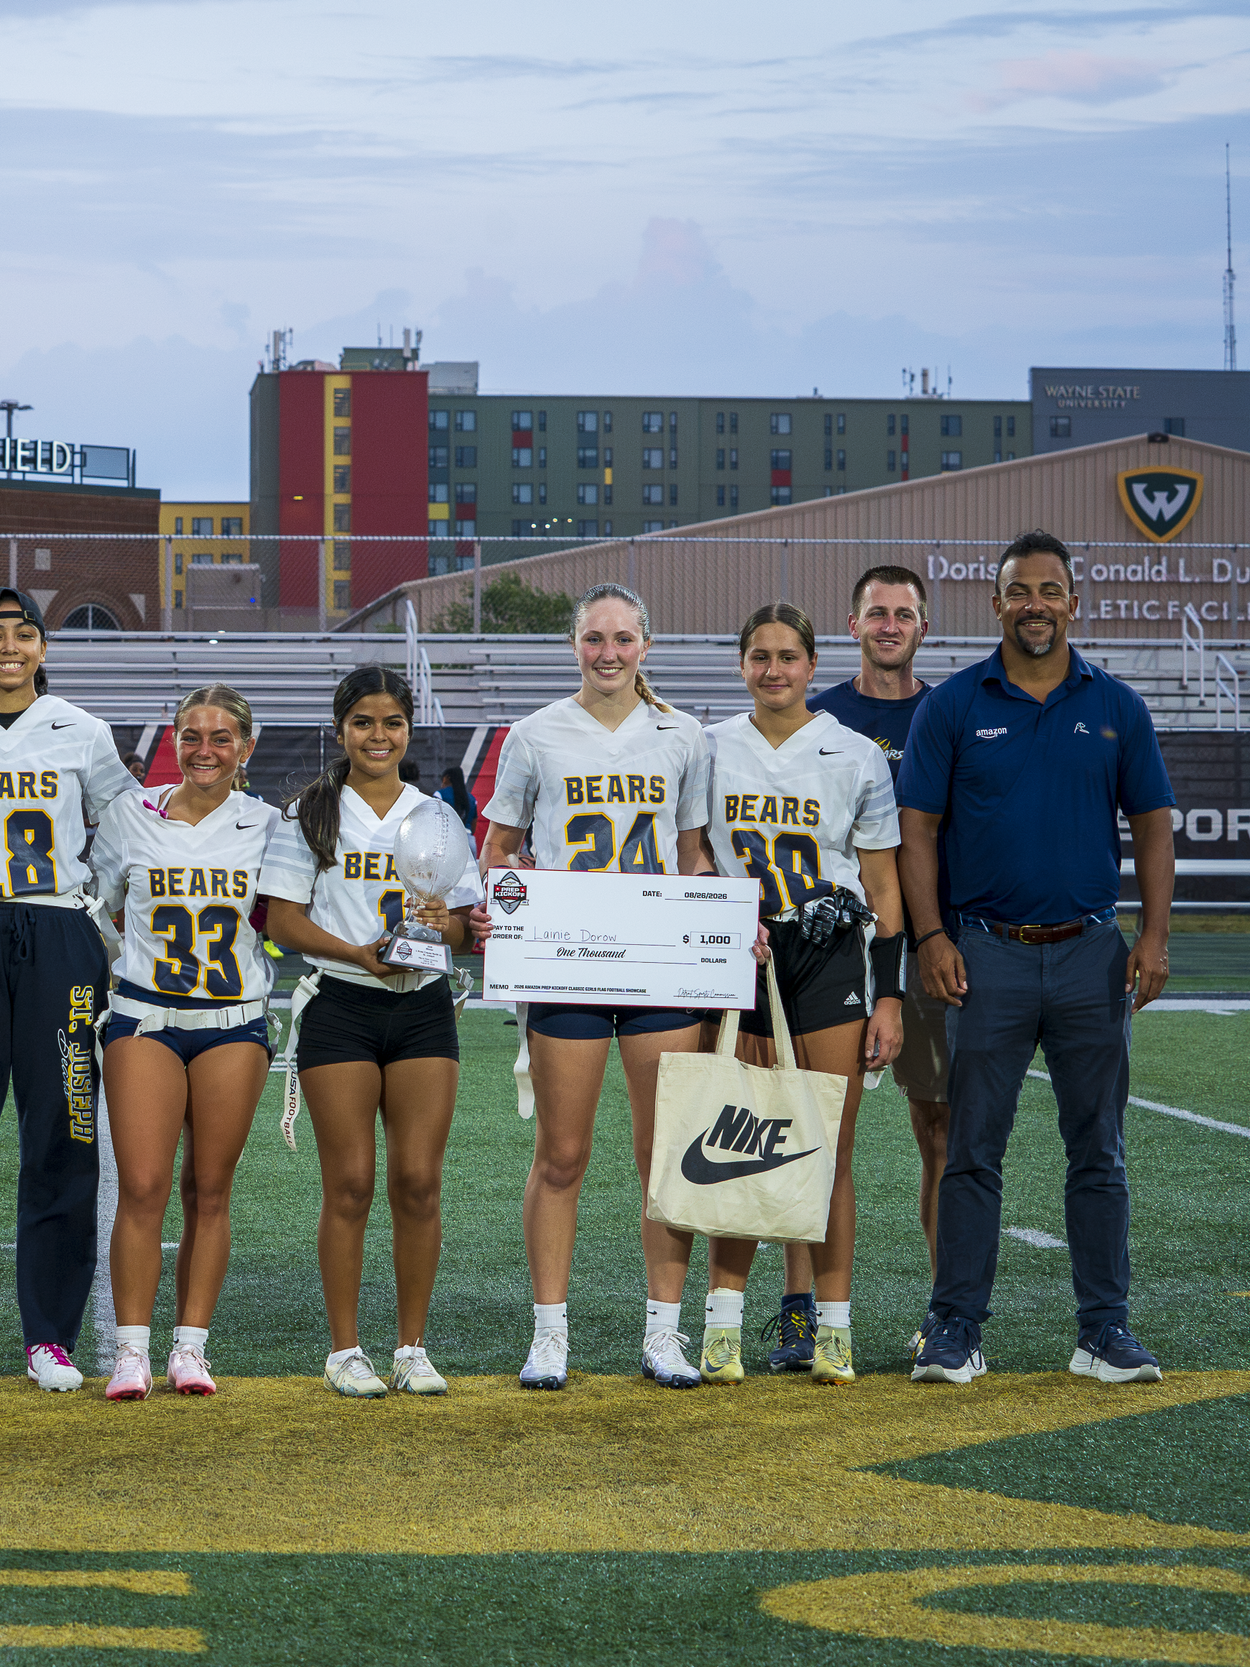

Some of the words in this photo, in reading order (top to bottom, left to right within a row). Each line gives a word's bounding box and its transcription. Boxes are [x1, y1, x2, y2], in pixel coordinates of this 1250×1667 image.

[1044, 385, 1095, 399] WAYNE
[1098, 386, 1141, 399] STATE
[1057, 400, 1127, 409] UNIVERSITY
[927, 555, 999, 581] Doris
[1179, 558, 1201, 582] L.
[976, 727, 1008, 739] amazon
[883, 749, 904, 759] ARS
[563, 775, 666, 806] BEARS
[724, 794, 821, 827] BEARS
[564, 811, 666, 874] 24
[343, 851, 402, 882] BEA
[148, 867, 249, 899] BEARS
[534, 926, 571, 941] Lainie
[580, 929, 617, 942] Dorow
[682, 934, 690, 944] $
[700, 934, 731, 945] 1,000
[150, 904, 244, 1000] 33
[556, 947, 576, 958] One
[578, 947, 627, 959] Thousand
[69, 985, 94, 1034] ST.
[68, 1042, 95, 1144] JOSEPH
[705, 1104, 793, 1157] NIKE
